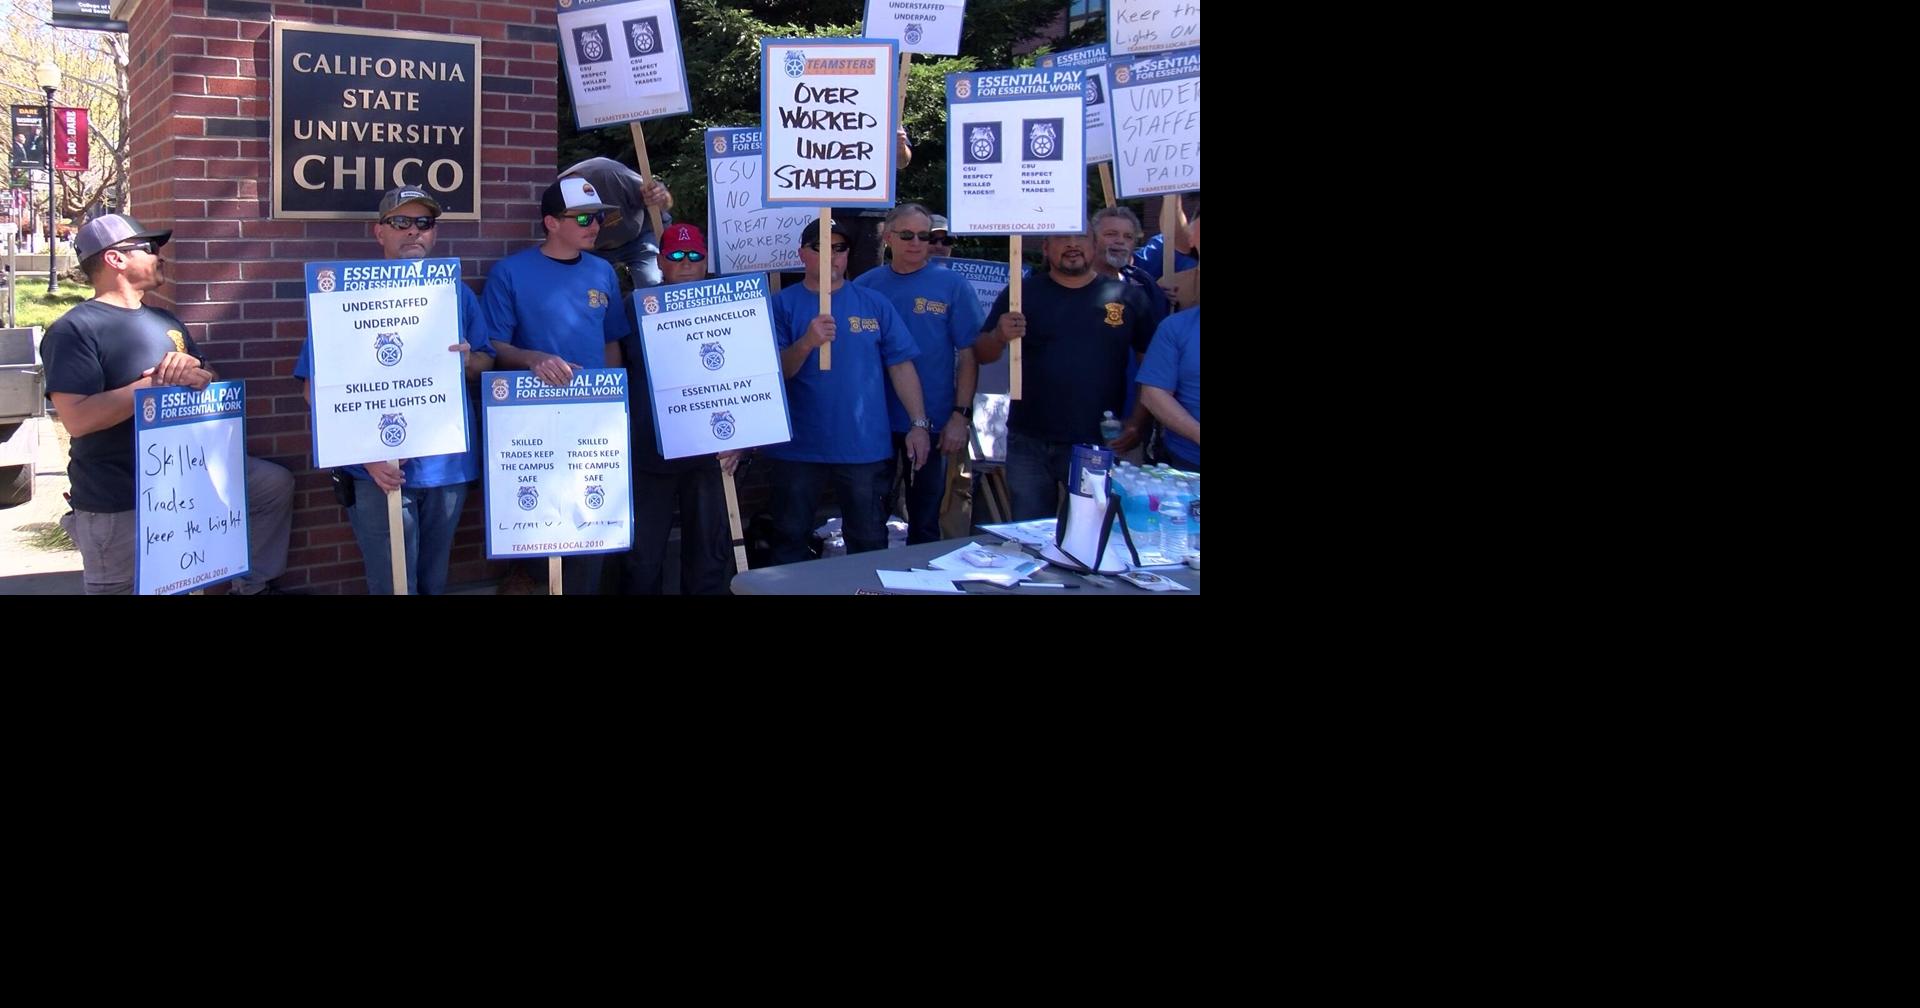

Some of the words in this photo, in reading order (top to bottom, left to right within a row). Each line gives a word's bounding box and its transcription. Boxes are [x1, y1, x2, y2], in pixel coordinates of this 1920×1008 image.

[888, 2, 944, 11] UNDERSTAFFED
[1117, 9, 1160, 24] Keep
[1174, 4, 1200, 18] th
[894, 13, 937, 22] UNDERPAID
[1116, 30, 1158, 46] Lights
[1170, 24, 1197, 38] ON
[1056, 46, 1107, 65] ESSENTIAL
[292, 52, 465, 82] CALIFORNIA
[632, 64, 658, 72] RESPECT
[808, 59, 875, 70] TEAMSTERS
[1136, 71, 1154, 80] FOR
[1155, 64, 1200, 78] ESSENTIA
[581, 71, 607, 79] RESPECT
[582, 78, 606, 86] SKILLED
[633, 70, 658, 79] SKILLED
[978, 73, 1050, 88] ESSENTIAL
[1053, 70, 1082, 82] PAY
[794, 82, 859, 104] OVER
[978, 88, 996, 96] FOR
[998, 84, 1048, 95] ESSENTIAL
[1050, 82, 1081, 92] WORK
[342, 88, 420, 112] STATE
[66, 111, 76, 134] DARE
[594, 113, 630, 124] TEAMSTERS
[630, 110, 650, 118] LOCAL
[652, 107, 667, 115] 2010
[778, 106, 877, 132] WORKED
[294, 119, 465, 145] UNIVERSITY
[732, 144, 750, 152] FOR
[796, 137, 874, 160] UNDER
[293, 154, 464, 192] CHICO
[714, 160, 756, 184] CSU
[774, 164, 876, 191] STAFFED
[1146, 164, 1194, 182] PAID
[726, 191, 750, 208] NO
[722, 217, 768, 234] TREAT
[776, 214, 812, 230] YOUR
[678, 227, 690, 241] A
[725, 234, 791, 252] WORKERS
[726, 254, 758, 270] YOU
[952, 262, 1006, 276] ESSENTIAL
[344, 264, 424, 281] ESSENTIAL
[427, 264, 456, 278] PAY
[966, 272, 1002, 282] ESSENTIAL
[344, 280, 366, 292] FOR
[368, 278, 421, 290] ESSENTIAL
[422, 276, 457, 288] WORK
[664, 283, 733, 303] ESSENTIAL
[736, 278, 761, 291] PAY
[342, 297, 428, 312] UNDERSTAFFED
[666, 302, 684, 312] FOR
[686, 294, 732, 308] ESSENTIAL
[733, 289, 763, 300] WORK
[354, 315, 420, 330] UNDERPAID
[656, 318, 692, 332] ACTING
[694, 308, 757, 326] CHANCELLOR
[686, 332, 704, 342] ACT
[706, 328, 732, 338] NOW
[346, 381, 390, 394] SKILLED
[392, 377, 434, 391] TRADES
[596, 373, 623, 386] PAY
[516, 390, 537, 398] FOR
[538, 387, 590, 398] ESSENTIAL
[592, 386, 624, 396] WORK
[682, 383, 732, 397] ESSENTIAL
[733, 380, 752, 390] PAY
[161, 390, 218, 408] ESSENTIAL
[219, 387, 241, 402] PAY
[334, 401, 362, 414] KEEP
[365, 399, 386, 411] THE
[390, 395, 426, 408] LIGHTS
[430, 394, 446, 404] ON
[668, 404, 688, 414] FOR
[690, 397, 738, 412] ESSENTIAL
[740, 392, 772, 404] WORK
[161, 406, 178, 418] FOR
[178, 403, 216, 416] ESSENTIAL
[217, 401, 242, 412] WORK
[145, 444, 208, 476] Skilled
[518, 475, 538, 483] SAFE
[584, 474, 604, 482] SAFE
[142, 488, 196, 513] Trades
[184, 520, 202, 540] the
[512, 542, 557, 552] TEAMSTERS
[559, 541, 584, 550] LOCAL
[585, 540, 604, 548] 2010
[180, 550, 205, 570] ON
[154, 577, 192, 594] TEAMSTERS
[192, 571, 213, 586] LOCAL
[213, 567, 228, 580] 2010
